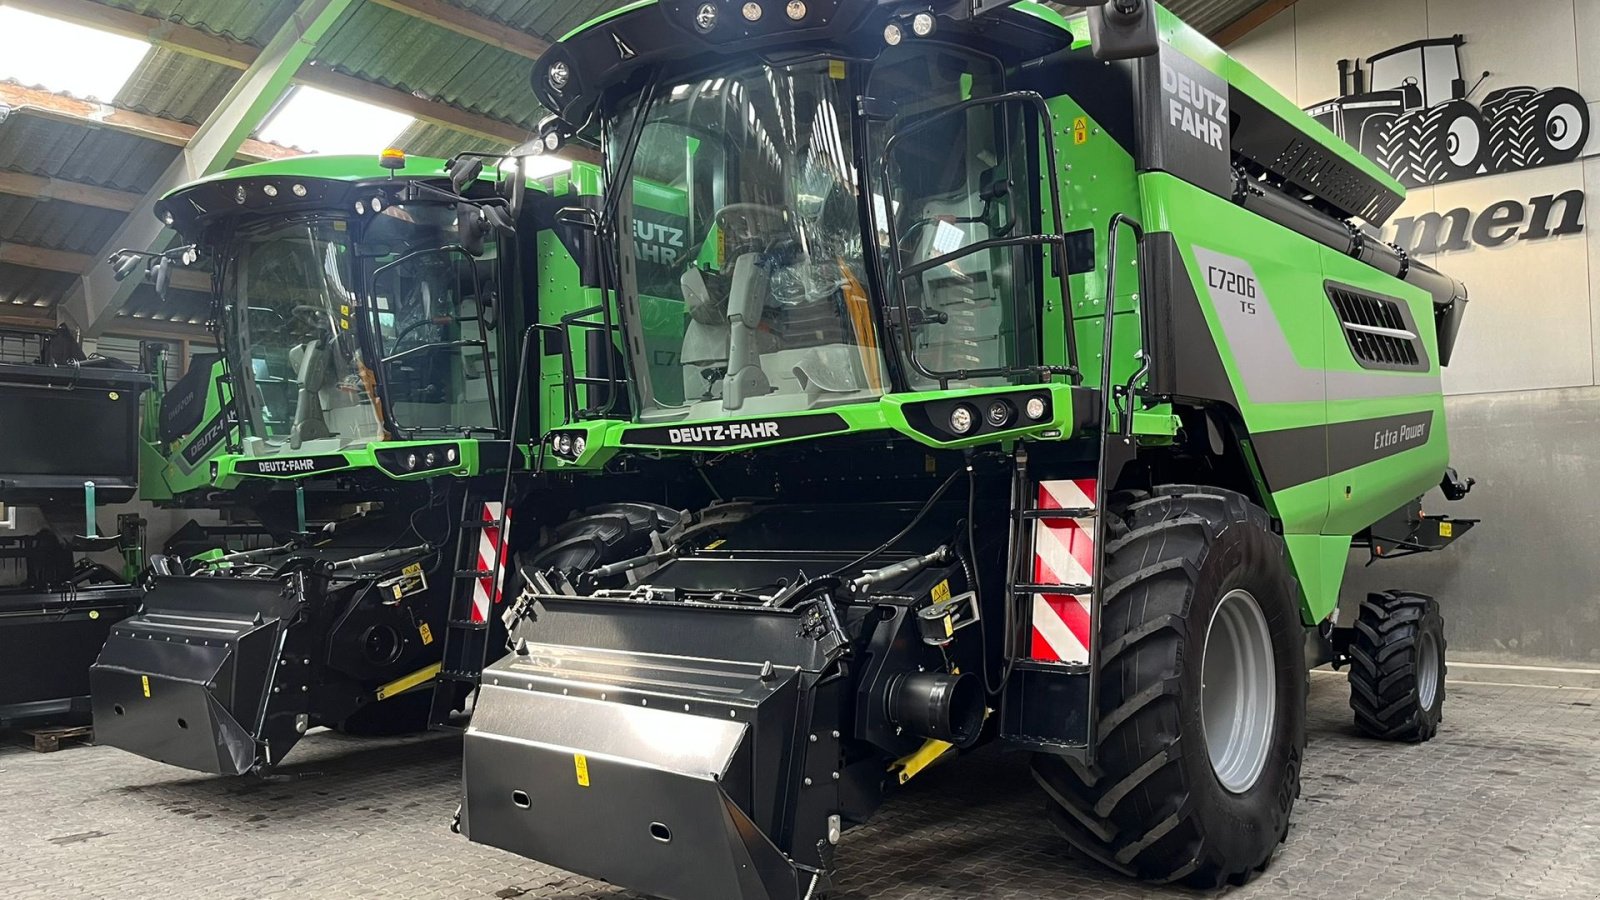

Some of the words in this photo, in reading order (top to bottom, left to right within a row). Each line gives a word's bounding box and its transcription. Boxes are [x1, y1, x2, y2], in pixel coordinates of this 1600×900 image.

[1162, 62, 1227, 124] DEUTZ
[1169, 99, 1223, 151] FAHR
[632, 218, 683, 248] UTZ
[1380, 189, 1585, 255] men
[633, 240, 677, 265] AHR
[1208, 265, 1256, 299] C7206
[1239, 300, 1256, 315] TS
[668, 421, 780, 443] DEUTZ-FAHR
[1373, 429, 1398, 450] Extra
[1399, 423, 1426, 442] Power
